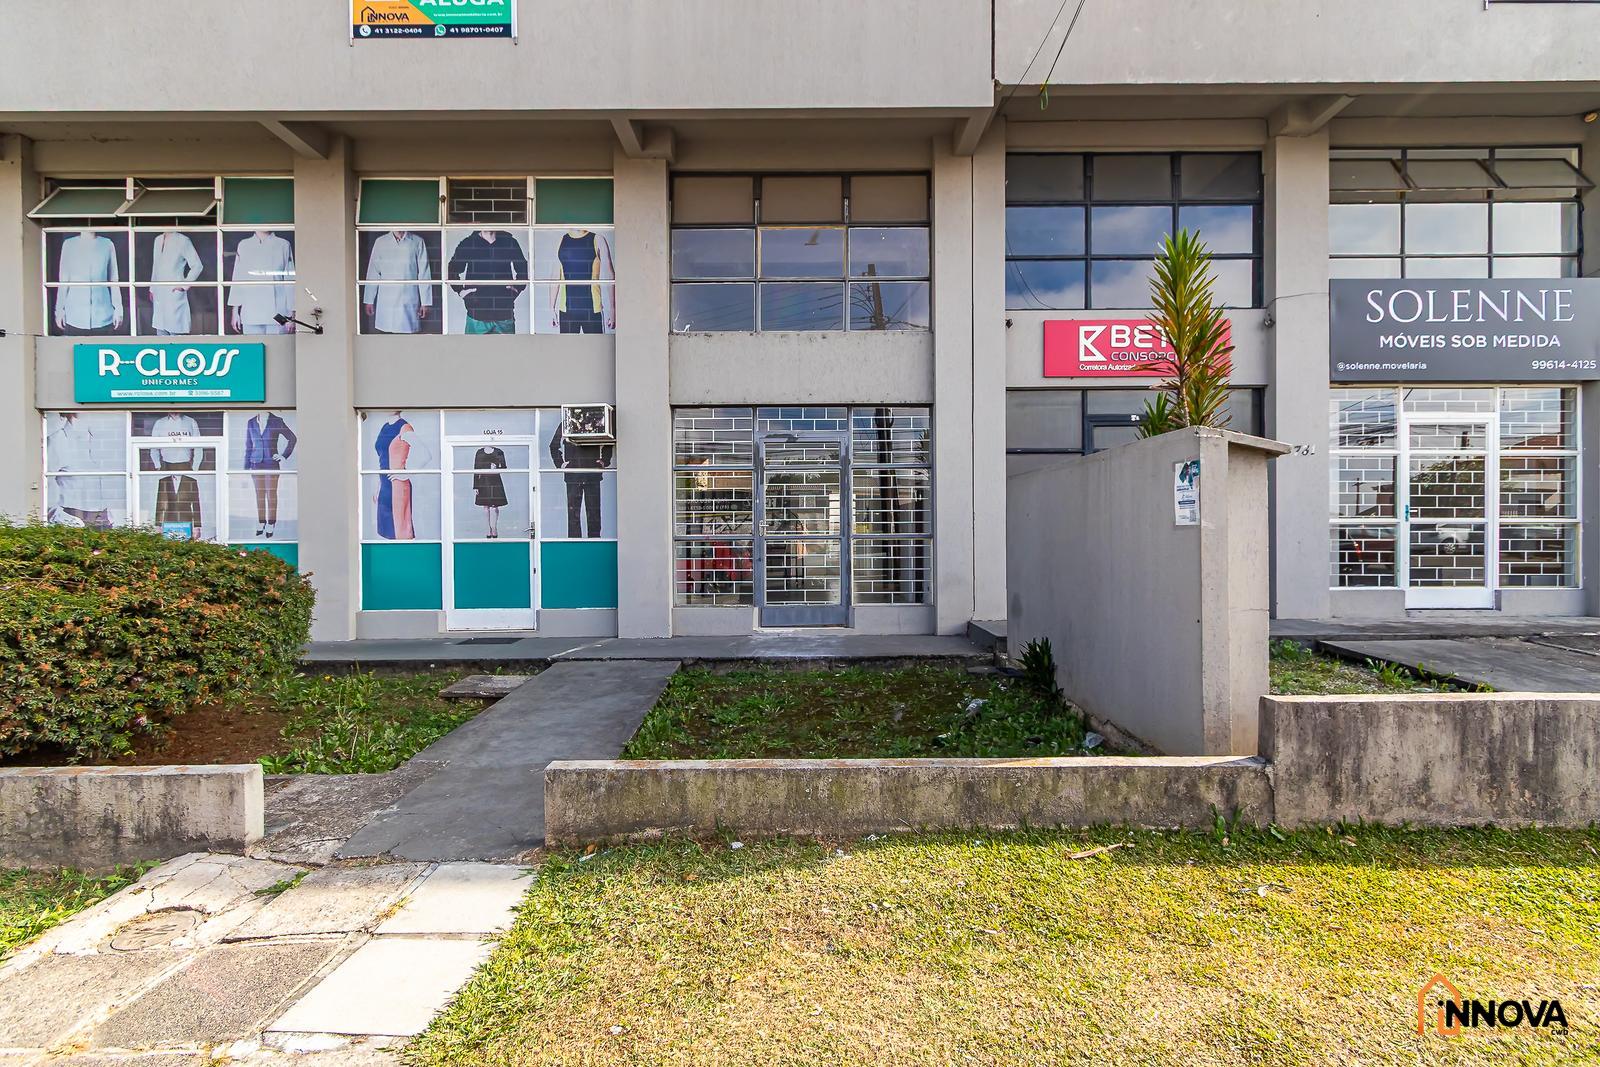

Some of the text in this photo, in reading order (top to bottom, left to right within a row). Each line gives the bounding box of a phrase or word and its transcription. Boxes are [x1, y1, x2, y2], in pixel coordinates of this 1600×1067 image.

[1366, 289, 1575, 323] SOLENNE
[1379, 332, 1561, 349] MÓVEIS SOB MEDIDA
[1337, 362, 1427, 371] @solenne.movelaria
[1532, 360, 1597, 370] 99614-4125
[141, 378, 199, 386] UNIFORMES
